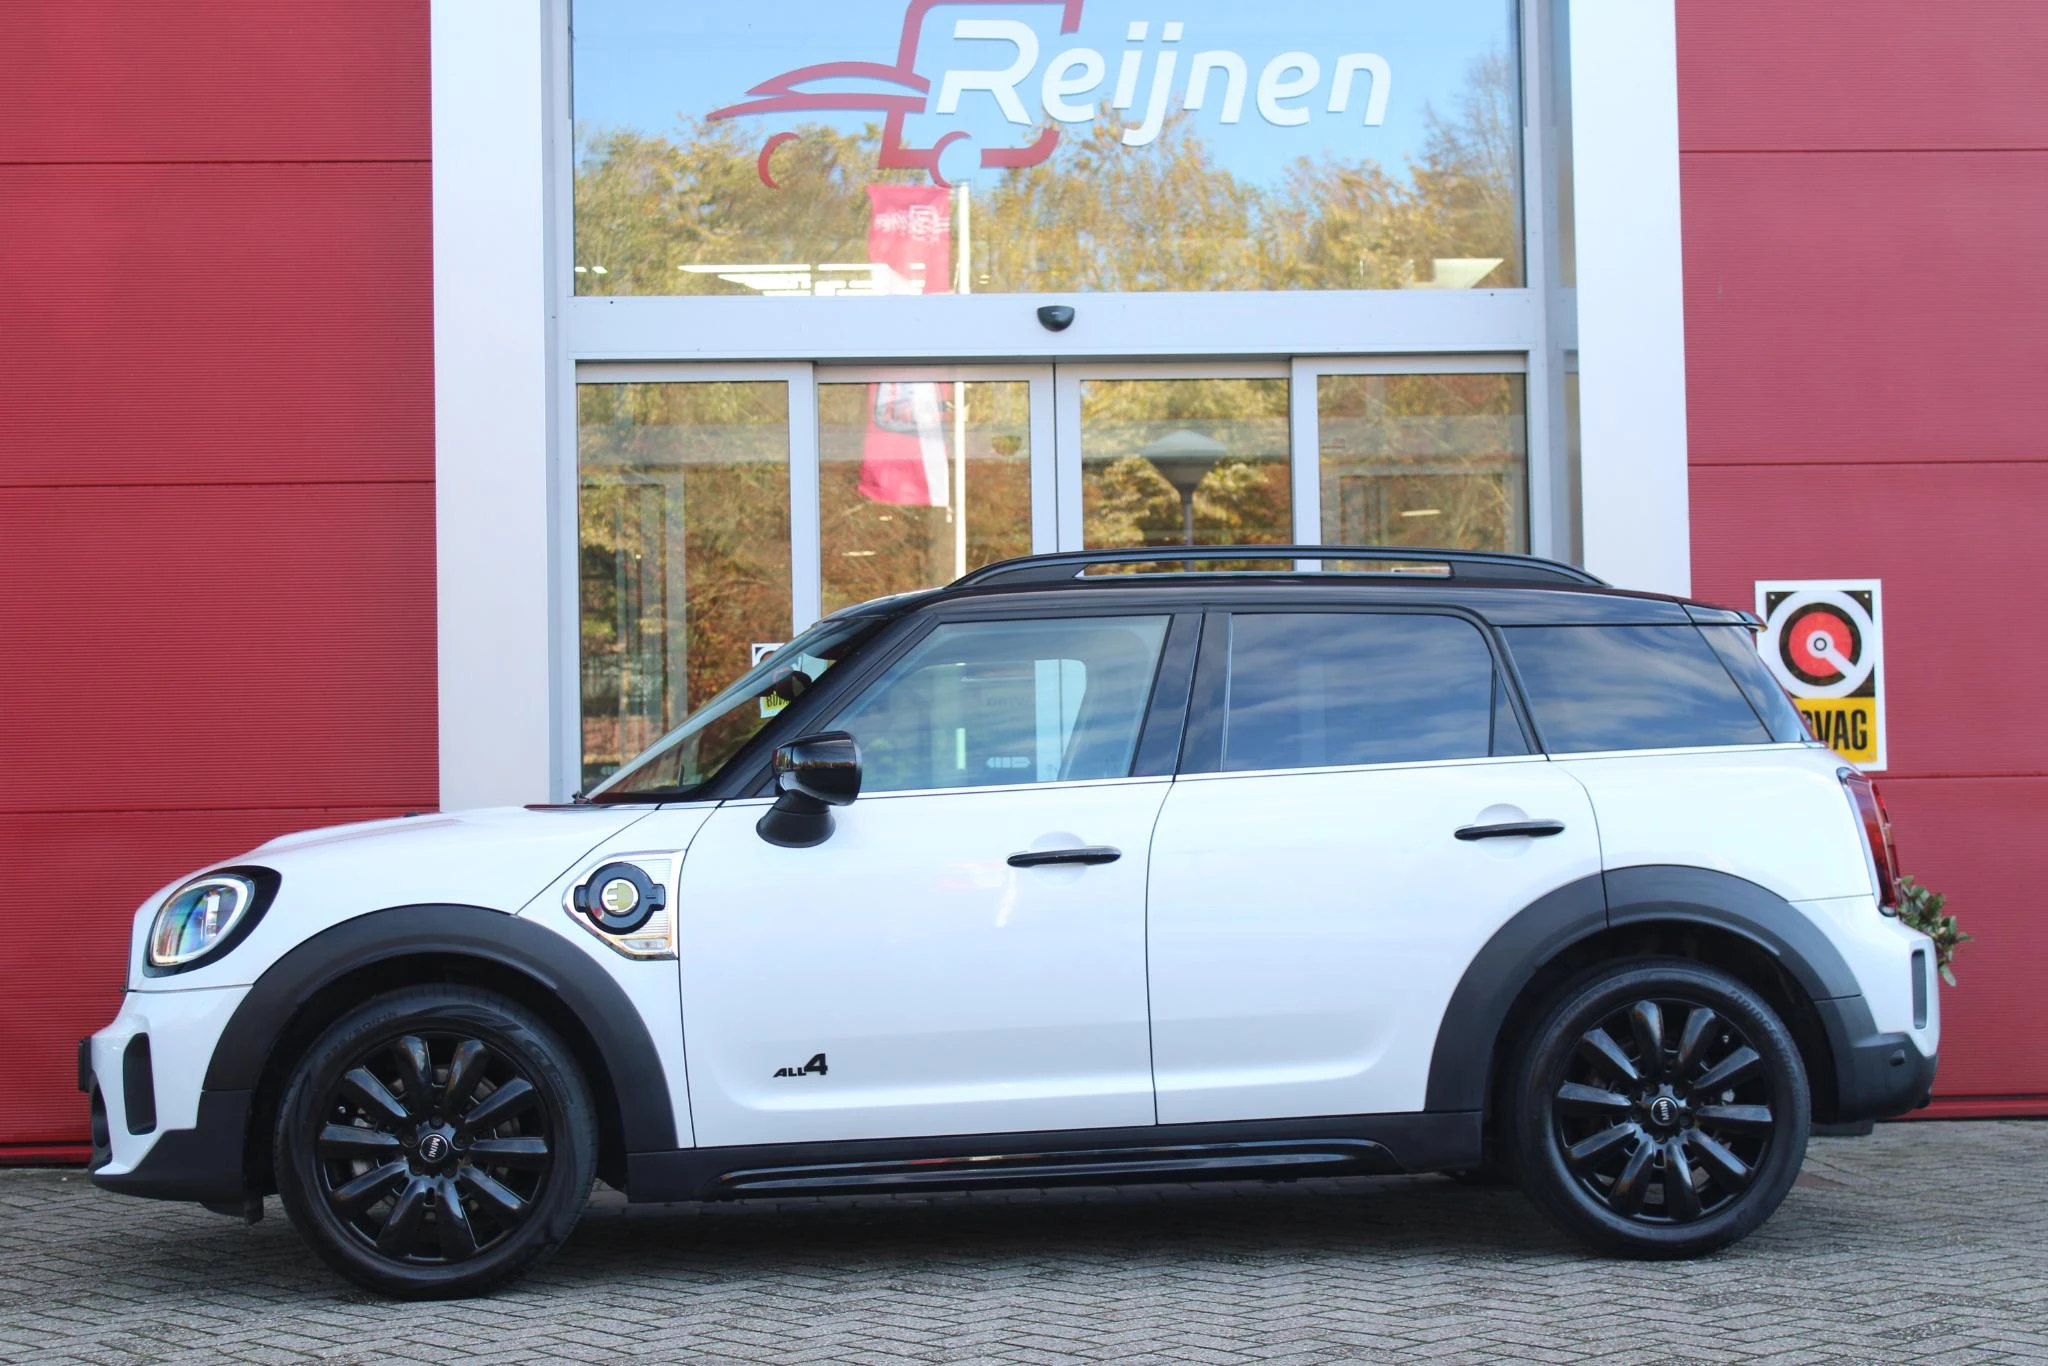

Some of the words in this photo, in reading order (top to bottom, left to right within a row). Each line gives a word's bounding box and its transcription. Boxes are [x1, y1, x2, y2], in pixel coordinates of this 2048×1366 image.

[936, 20, 1391, 147] Reijnen
[773, 1053, 828, 1078] ALL4
[1658, 1101, 1671, 1121] MINI
[428, 1136, 441, 1158] MINI
